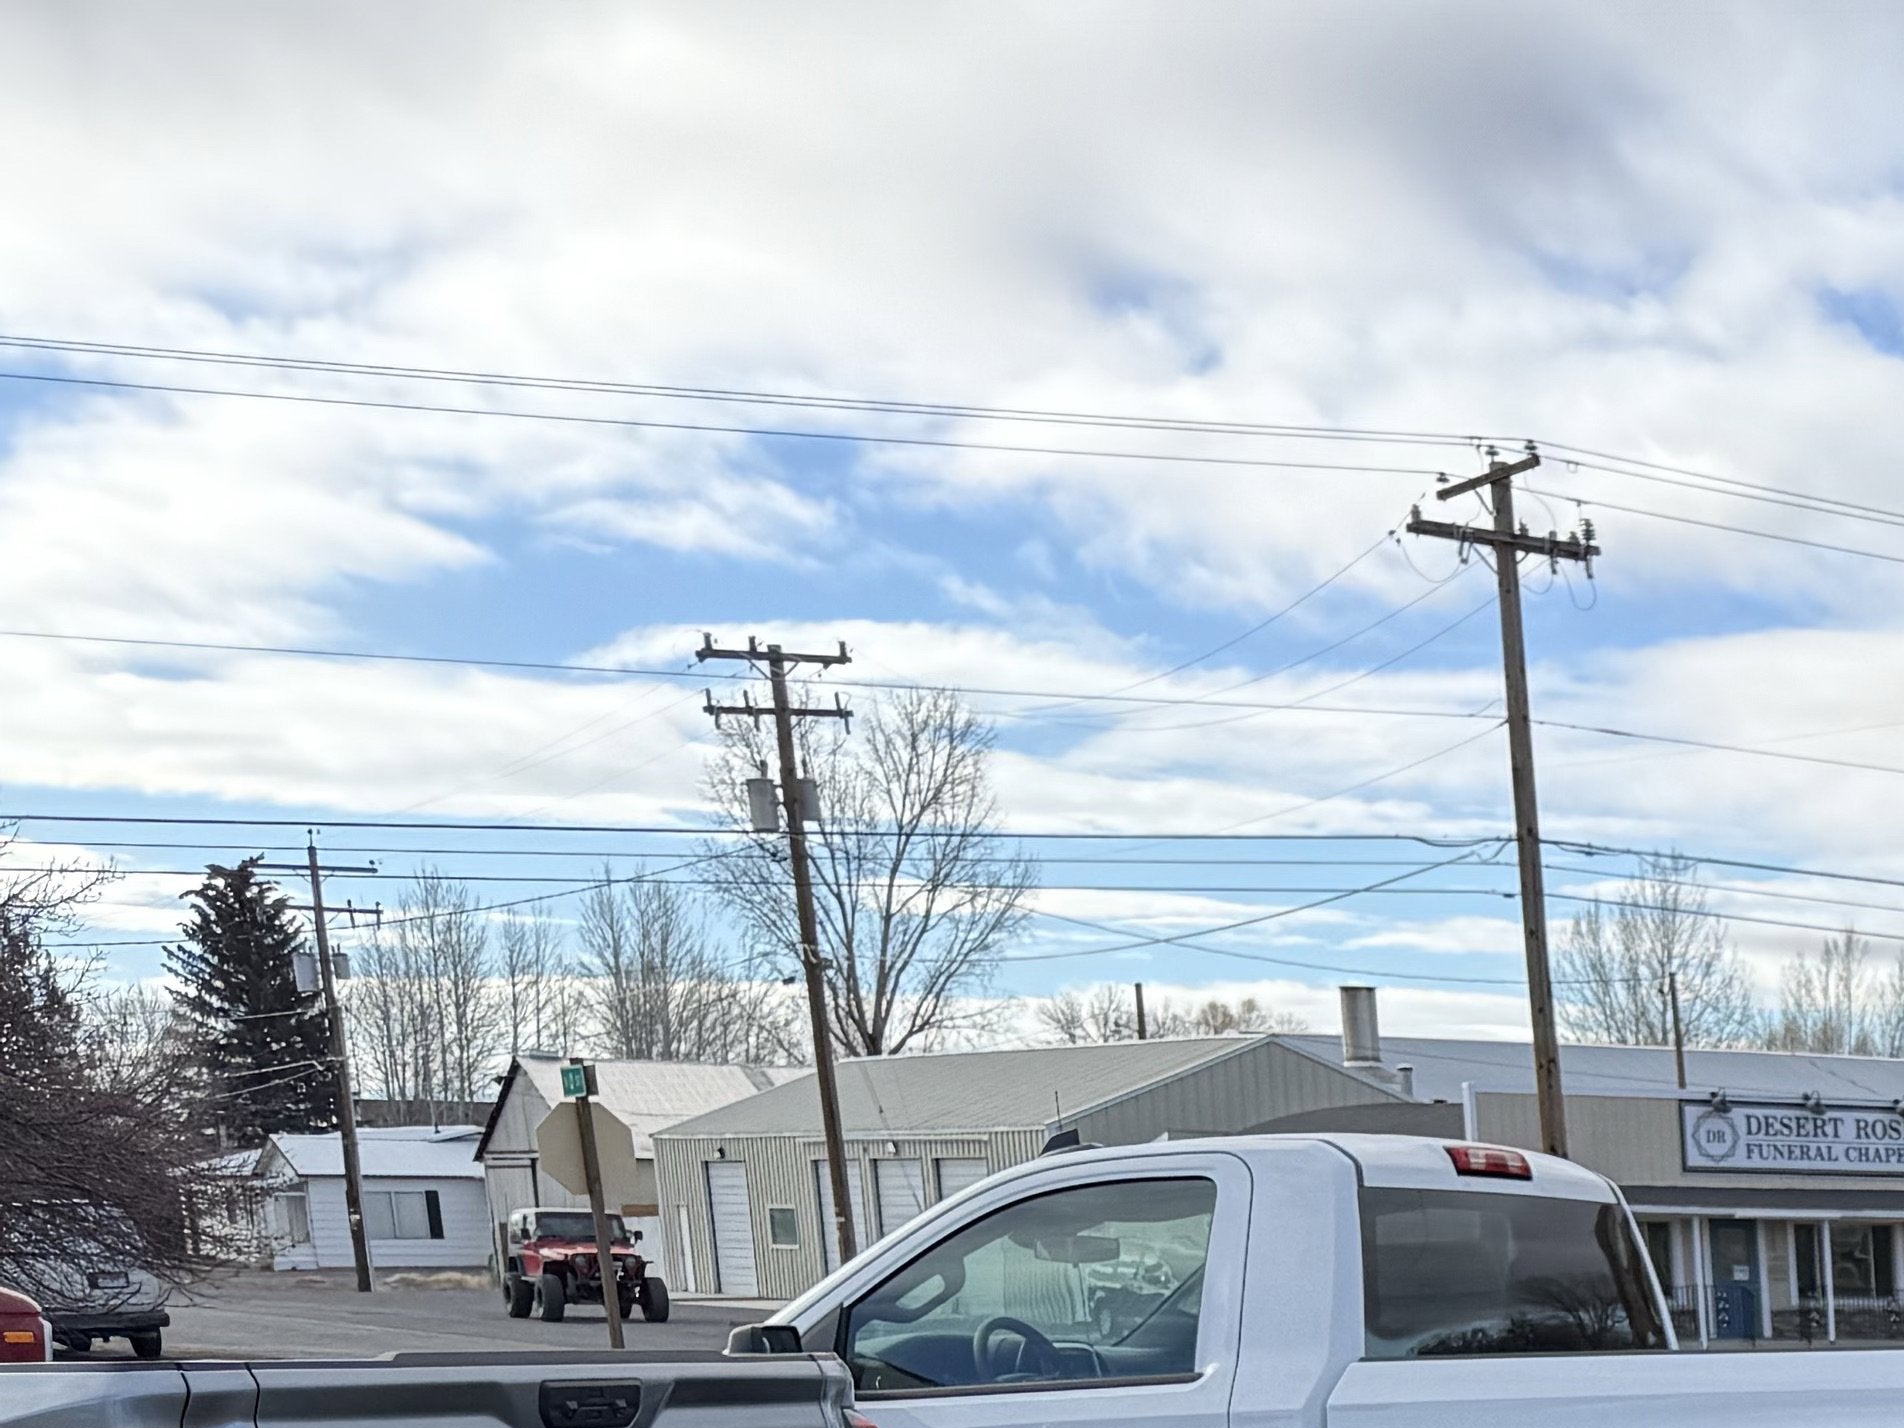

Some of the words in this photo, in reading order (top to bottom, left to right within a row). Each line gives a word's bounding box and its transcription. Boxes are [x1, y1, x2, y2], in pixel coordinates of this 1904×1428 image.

[1745, 1113, 1844, 1139] DESERT
[1706, 1129, 1727, 1145] DR
[1745, 1143, 1838, 1162] FUNERAL
